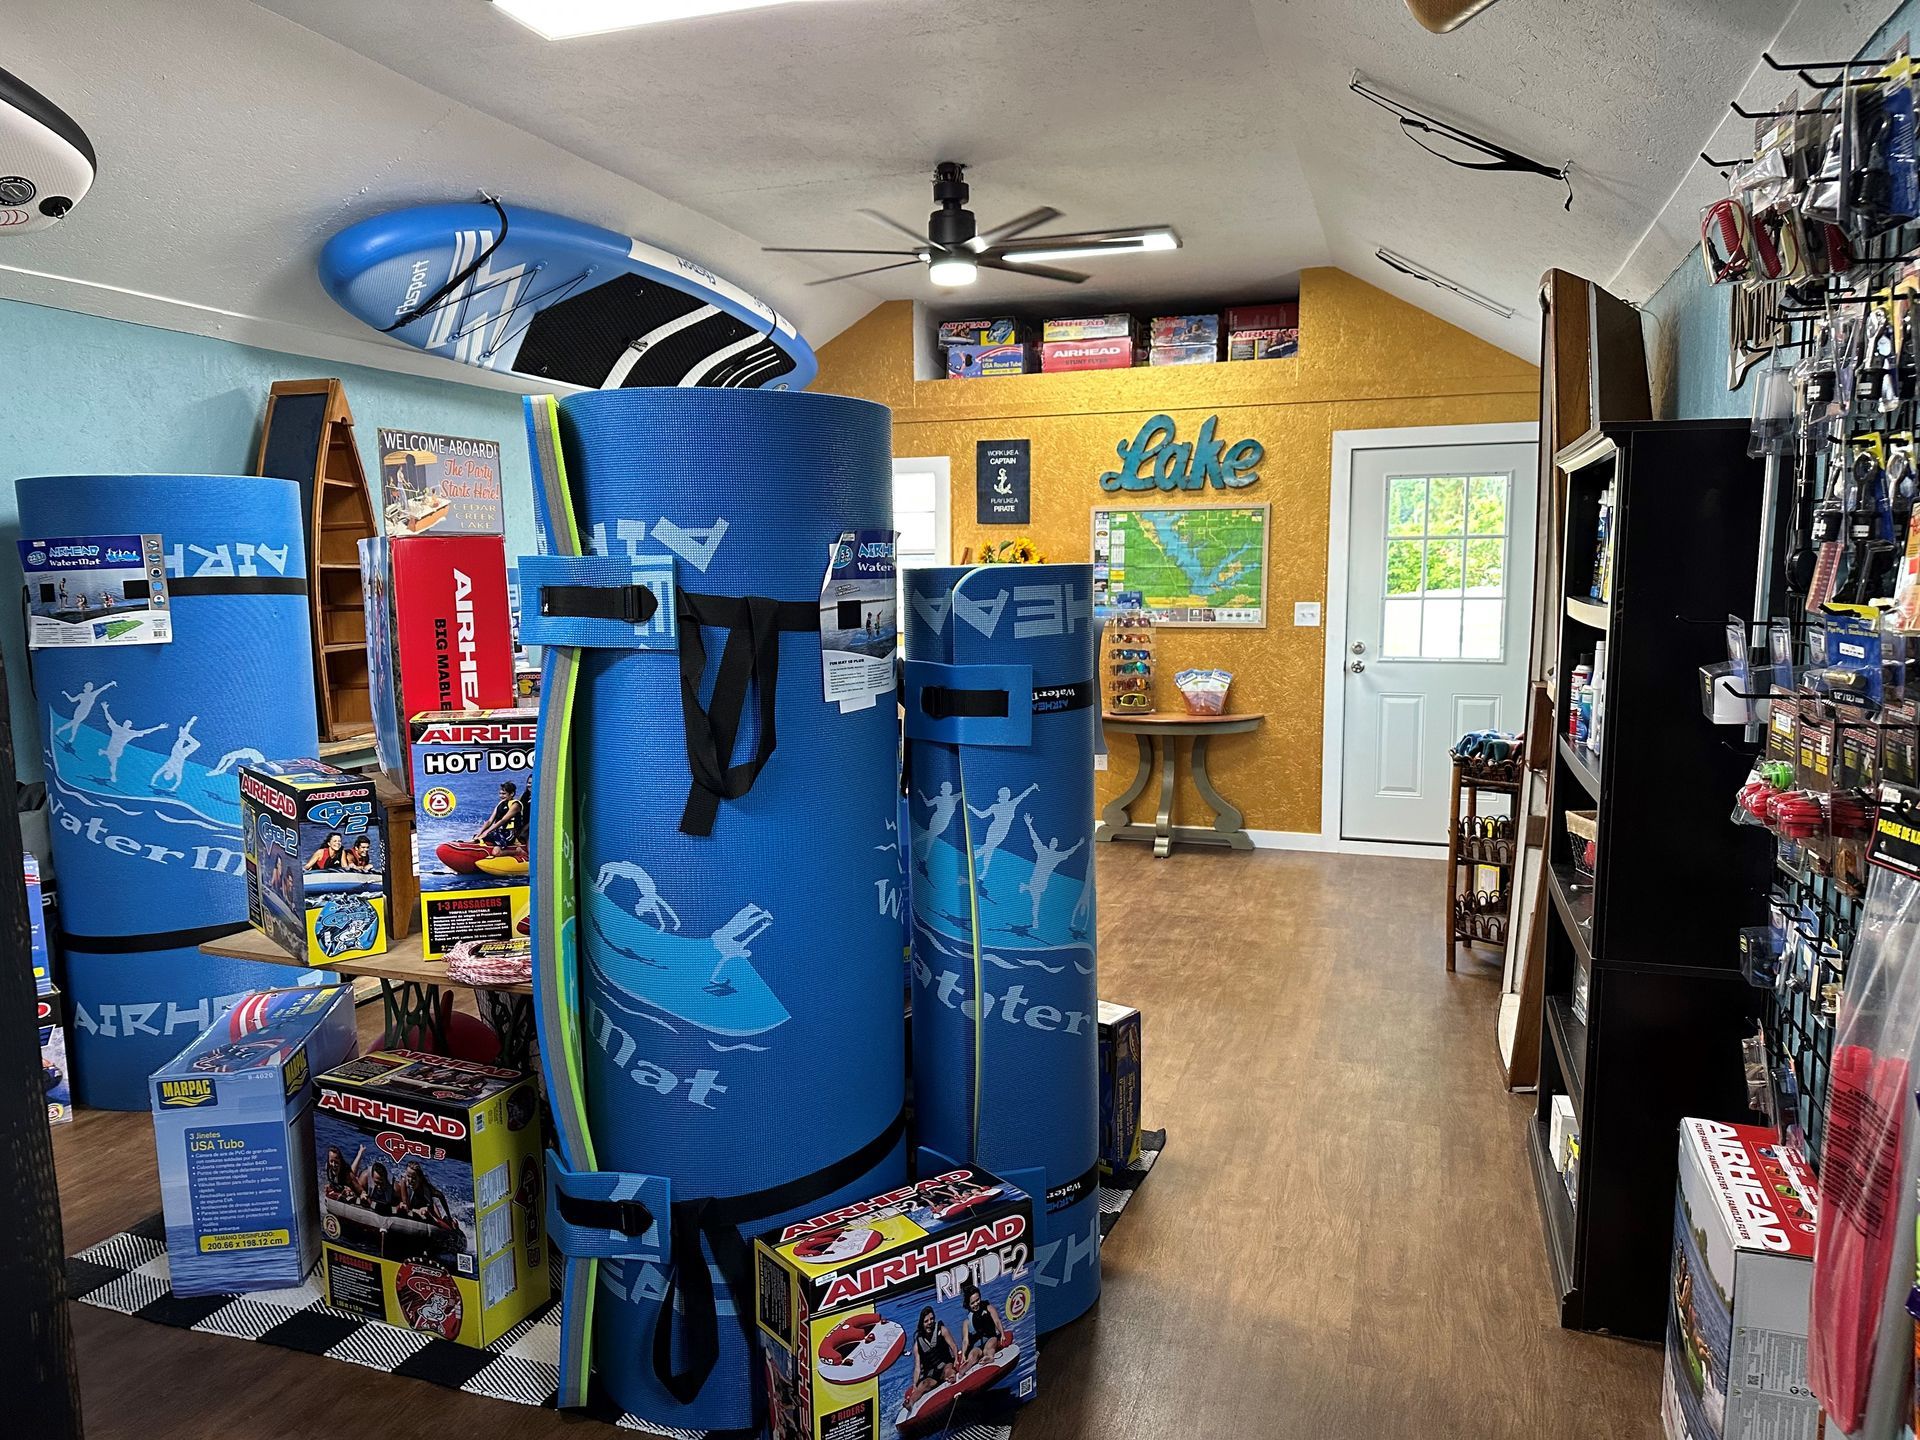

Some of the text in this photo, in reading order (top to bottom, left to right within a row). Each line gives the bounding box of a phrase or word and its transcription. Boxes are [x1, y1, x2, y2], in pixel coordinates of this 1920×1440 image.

[1053, 347, 1121, 358] AIRHEAD
[383, 432, 498, 459] WELCOME ABOARD!
[1099, 413, 1265, 492] Lake
[444, 459, 493, 485] The Party
[440, 480, 500, 500] Starts Here!
[453, 503, 496, 512] CEDAR
[455, 513, 495, 521] CREEK
[49, 545, 100, 557] AIRHEAD
[857, 543, 895, 558] AIRH
[434, 618, 452, 711] BIG MABLE
[425, 752, 481, 774] HOT
[241, 775, 298, 820] AIRHEAD
[306, 789, 369, 801] AIRHEAD
[437, 898, 503, 911] 1-3 PASSAGERS
[285, 1049, 307, 1085] MARPAC
[383, 1049, 522, 1078] AIRHEAD
[162, 1078, 211, 1098] MARPAC
[318, 1090, 466, 1140] AIRHEAD
[191, 1139, 245, 1151] USA Tubo
[196, 1132, 221, 1140] Jinetes
[434, 1148, 446, 1160] 3
[1694, 1123, 1706, 1137] FLYER
[1700, 1136, 1713, 1153] FAMILY
[1708, 1155, 1724, 1176] FAMILLE
[1717, 1176, 1729, 1190] FLYER
[1738, 1224, 1751, 1240] FLYER
[1708, 1120, 1792, 1253] AIRHEAD
[780, 1170, 973, 1243] AIRHEAD
[818, 1215, 1026, 1311] AIRHEAD
[837, 1403, 866, 1421] RIDERS
